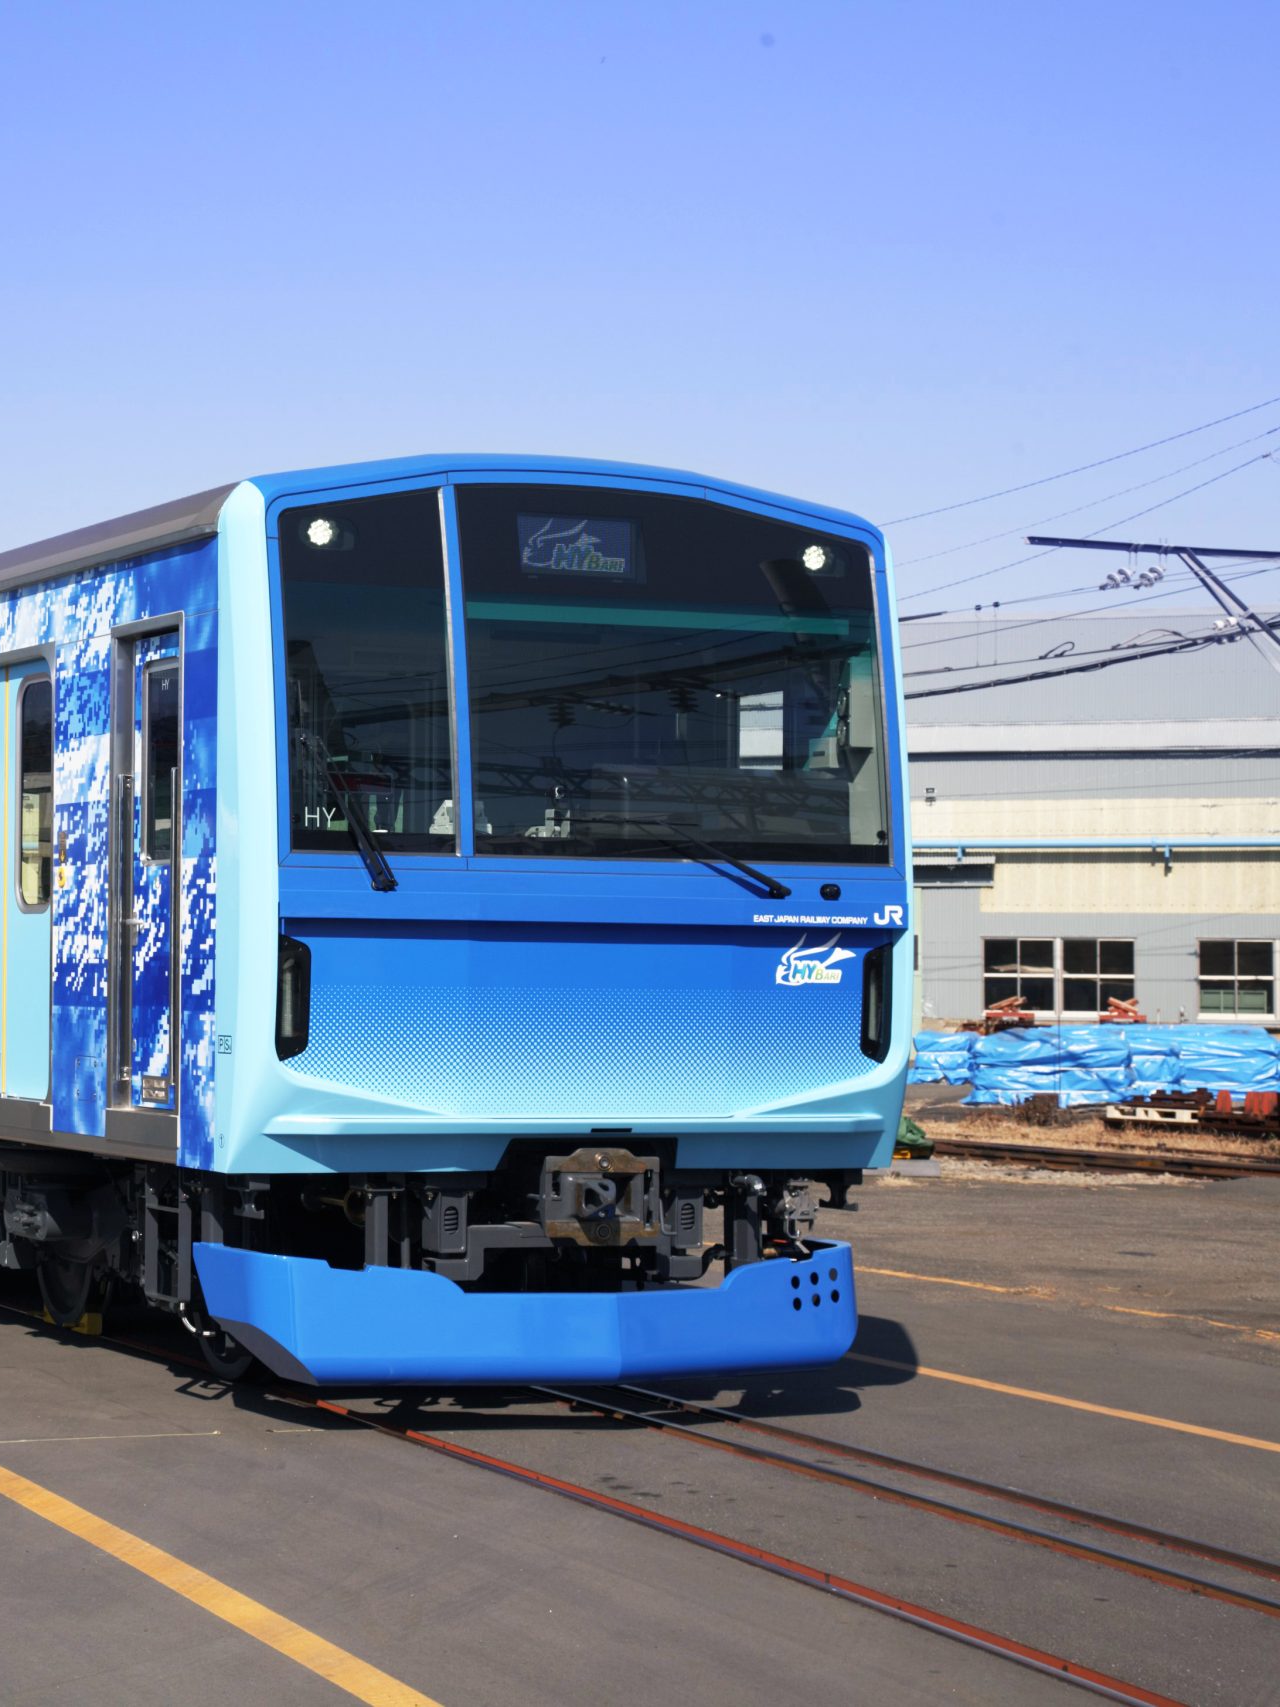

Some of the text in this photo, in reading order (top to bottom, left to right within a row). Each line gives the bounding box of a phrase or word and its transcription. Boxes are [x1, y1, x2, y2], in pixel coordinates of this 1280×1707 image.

[304, 806, 336, 828] HY
[753, 905, 903, 926] EAST JAPAN RAILWAY COMPANY JR
